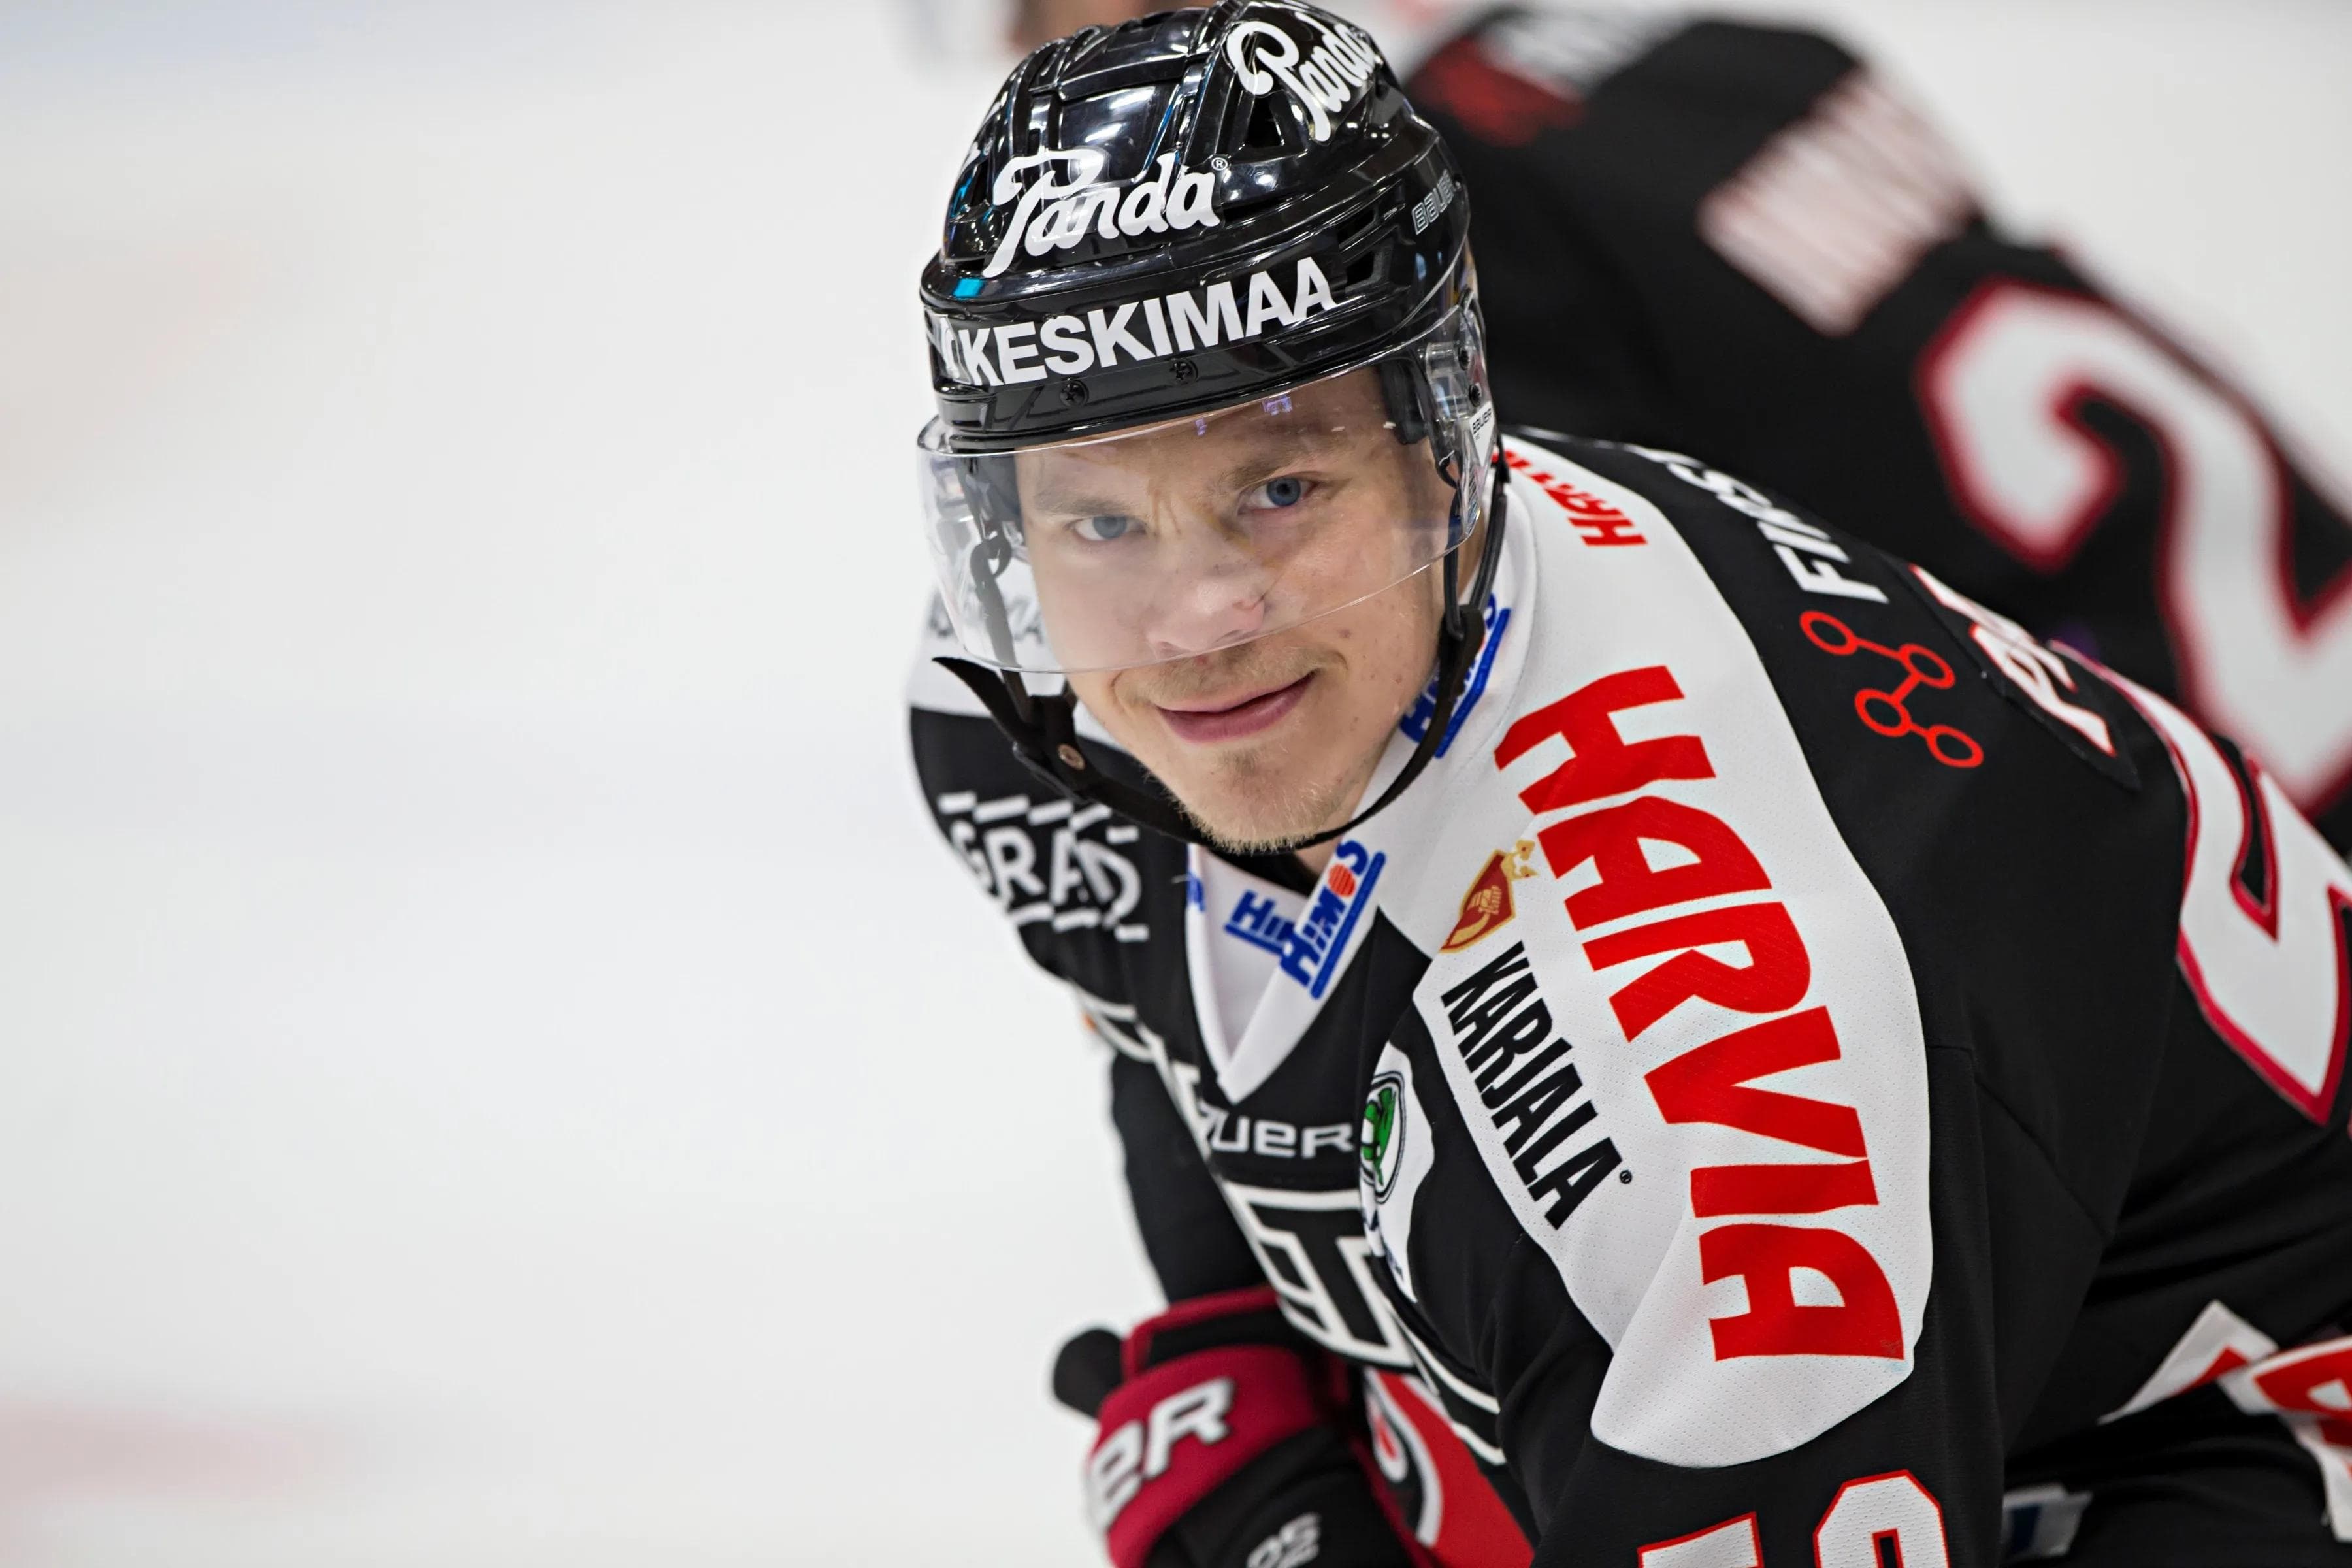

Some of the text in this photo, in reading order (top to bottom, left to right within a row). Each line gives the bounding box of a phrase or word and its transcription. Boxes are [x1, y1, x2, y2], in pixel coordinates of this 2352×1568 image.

[1226, 11, 1375, 142] Panda
[958, 256, 1341, 387] KESKIMAA
[1494, 665, 1905, 1362] HARVIA
